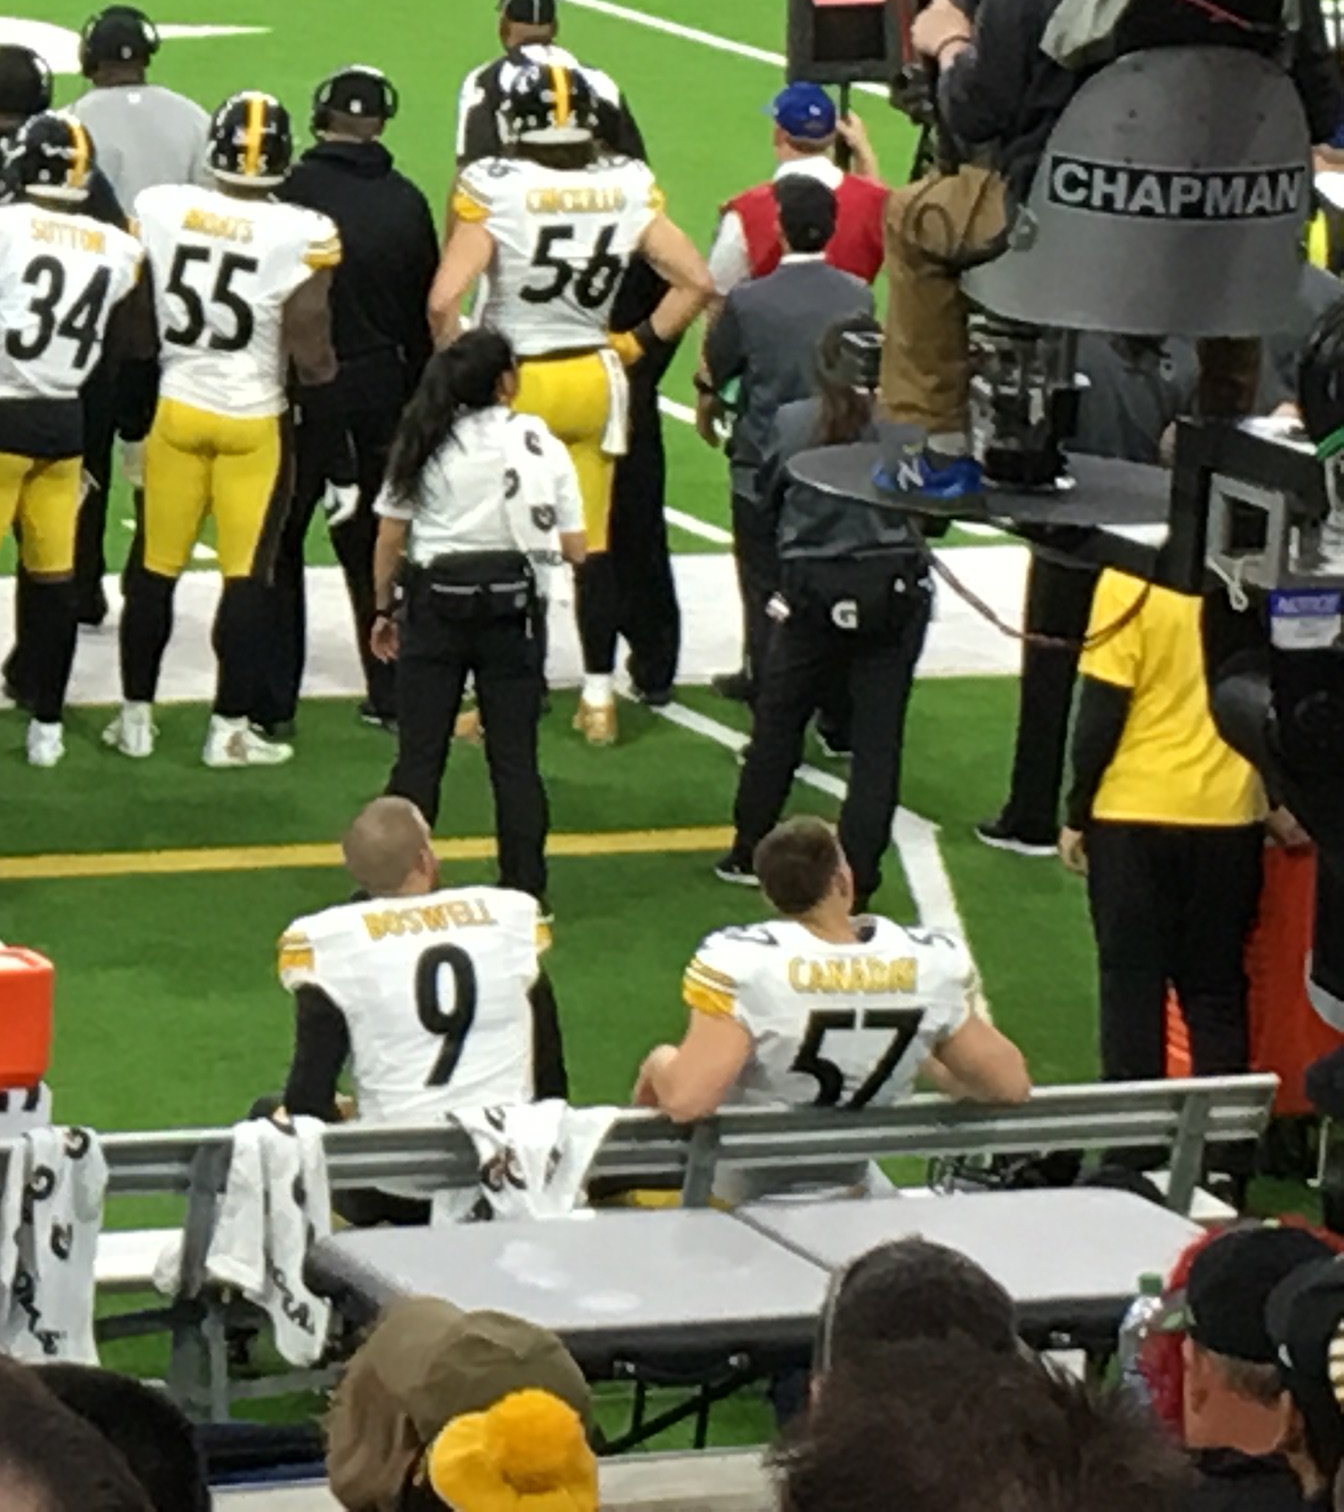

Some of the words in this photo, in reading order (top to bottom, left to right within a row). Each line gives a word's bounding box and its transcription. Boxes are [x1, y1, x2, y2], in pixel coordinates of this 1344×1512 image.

[1053, 162, 1302, 218] CHAPMAN
[4, 254, 111, 369] 34
[163, 242, 259, 352] 55
[518, 223, 620, 309] 56
[415, 942, 479, 1088] 9
[788, 1008, 930, 1111] 57
